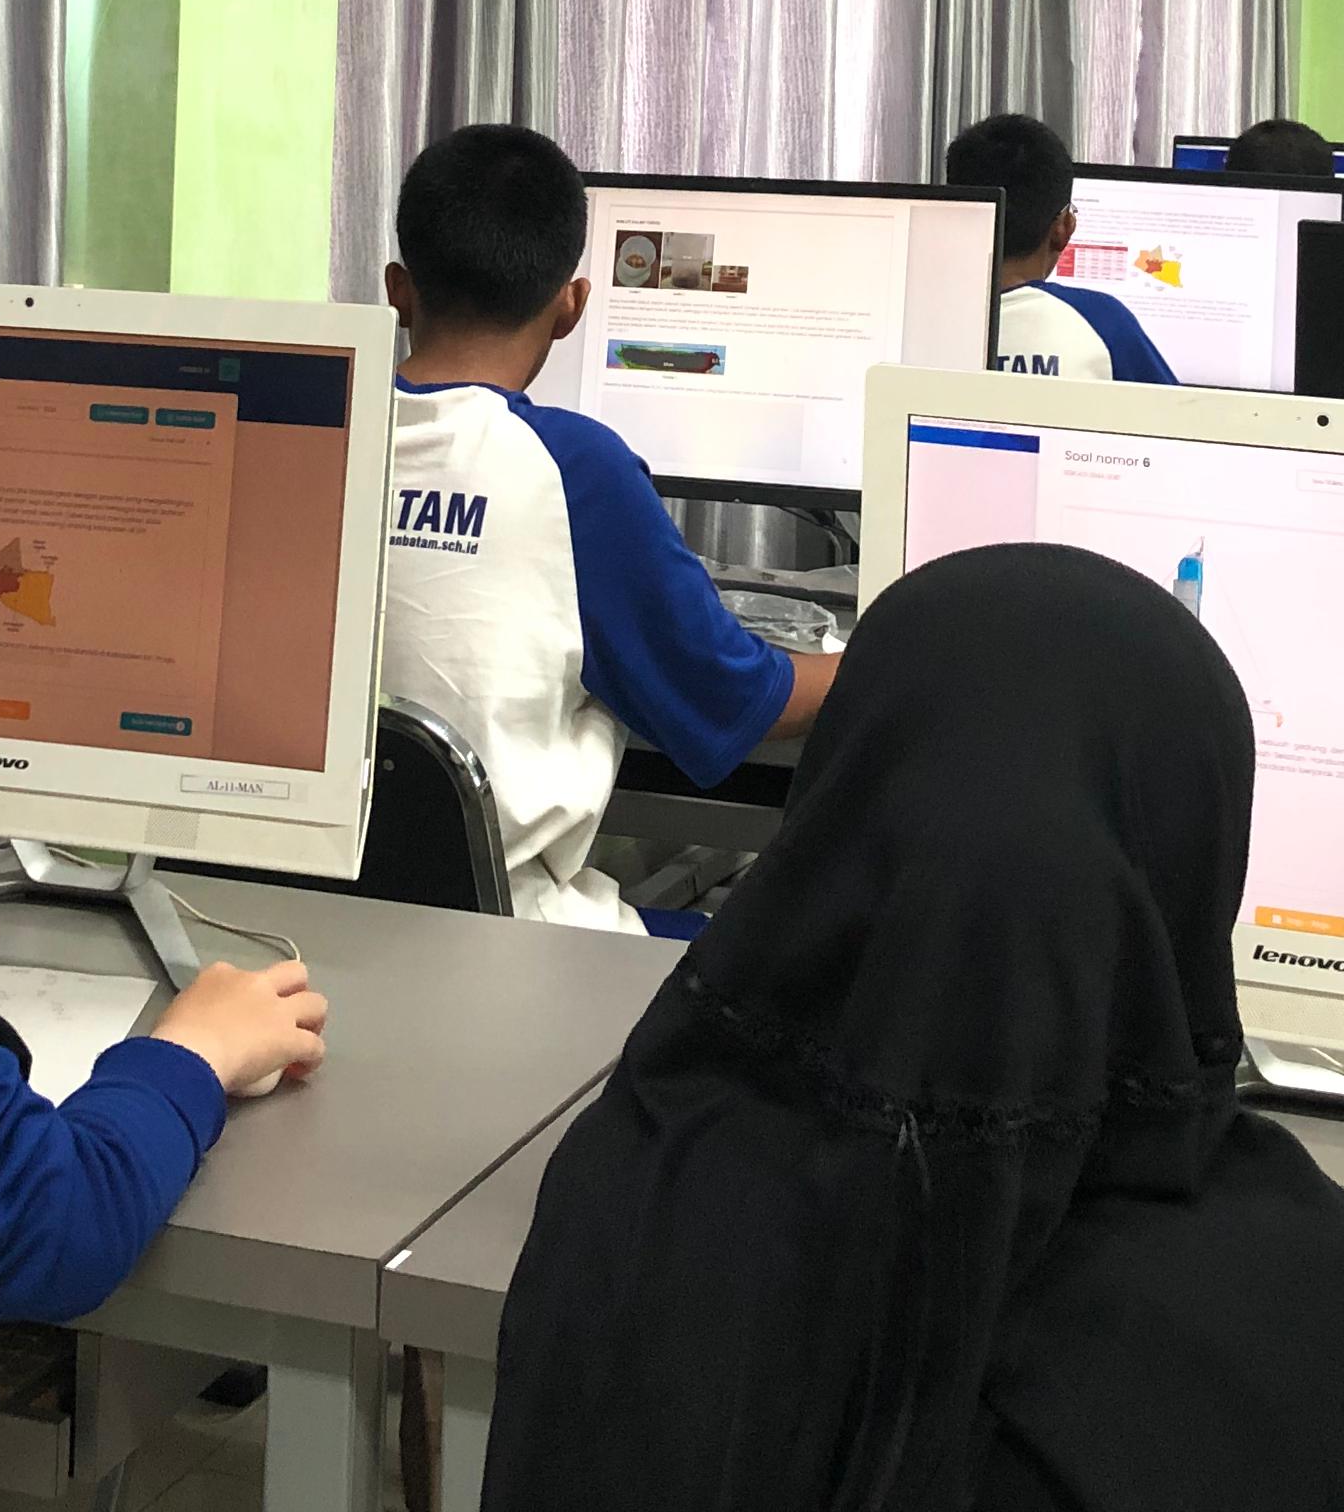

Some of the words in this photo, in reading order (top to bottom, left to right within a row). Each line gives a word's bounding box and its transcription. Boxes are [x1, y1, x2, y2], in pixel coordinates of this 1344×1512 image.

[1064, 450, 1093, 463] Soal
[1096, 454, 1139, 467] nomor
[1142, 457, 1151, 468] 6
[391, 489, 488, 538] TAM
